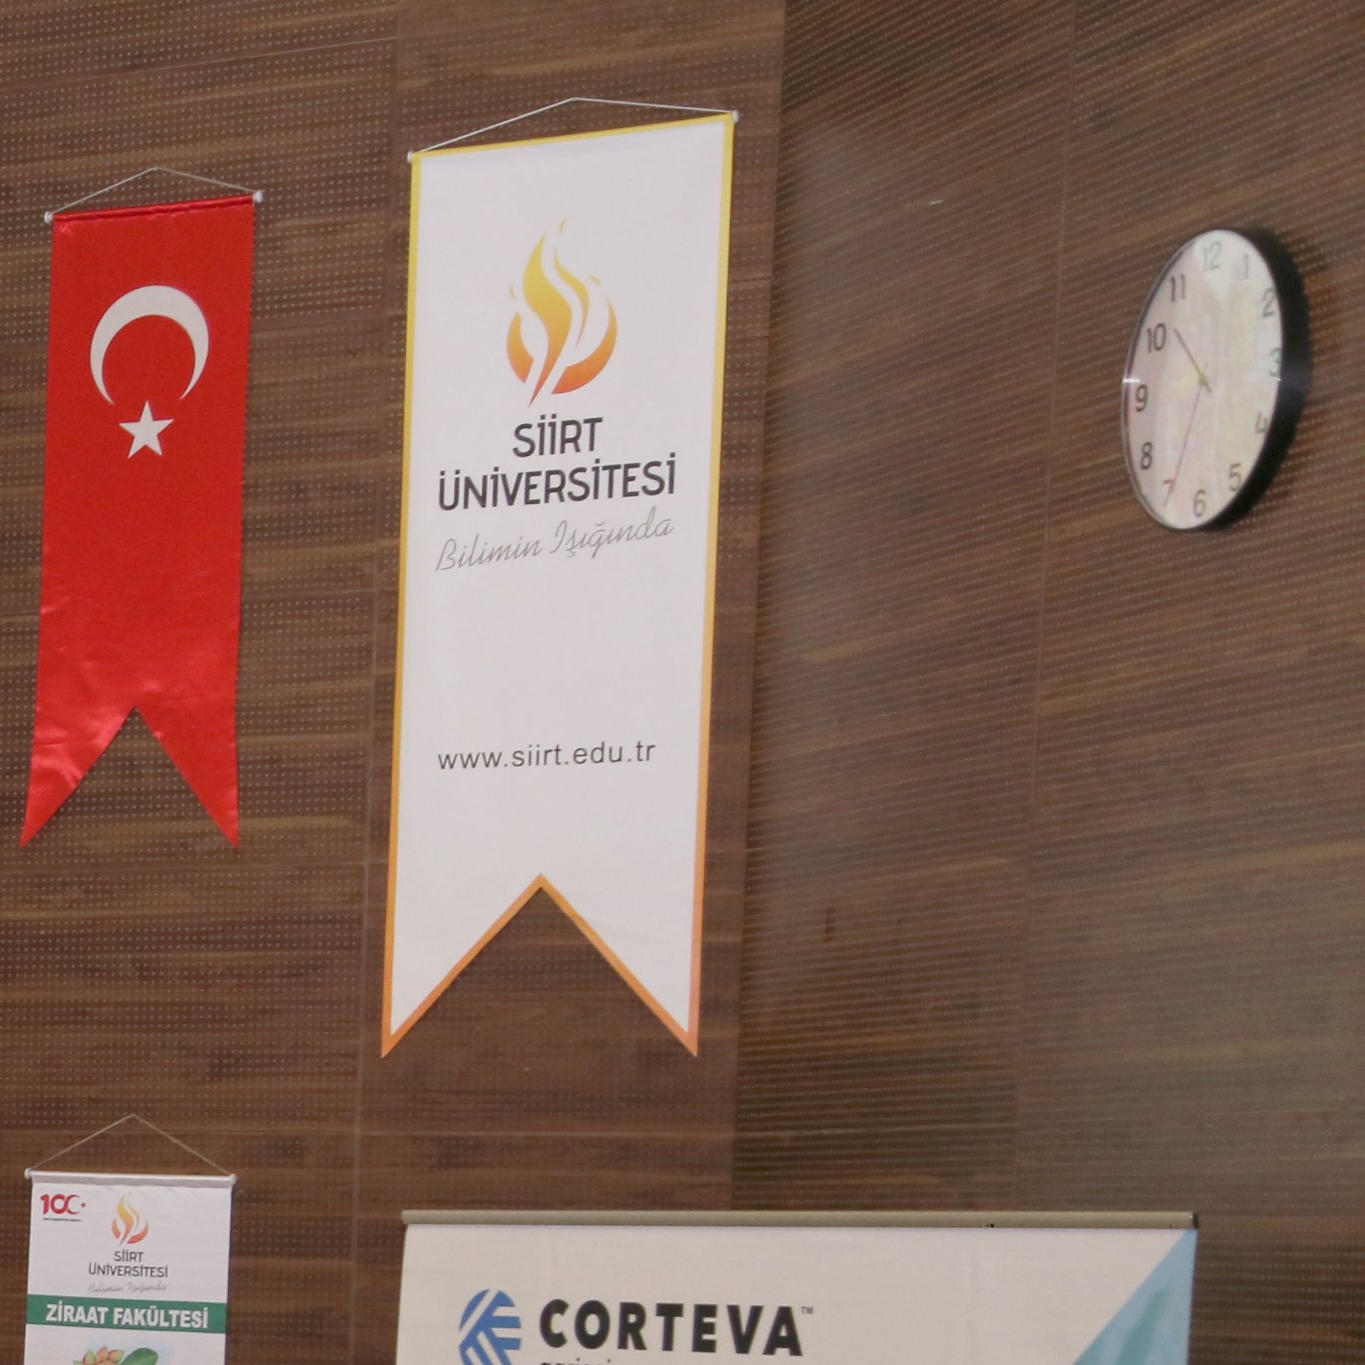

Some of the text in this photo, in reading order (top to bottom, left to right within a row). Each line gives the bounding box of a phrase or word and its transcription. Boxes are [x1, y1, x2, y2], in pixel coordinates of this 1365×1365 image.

[1202, 240, 1224, 271] 12
[1170, 273, 1187, 303] 11
[1262, 287, 1275, 318] 2
[1146, 322, 1166, 354] 10
[1135, 384, 1149, 412] 9
[513, 415, 603, 458] SİİRT
[1255, 411, 1269, 434] 4
[1140, 441, 1153, 470] 8
[438, 453, 677, 511] ÜNİVERSİTESİ
[1229, 463, 1243, 492] 5
[1193, 488, 1207, 518] 6
[435, 507, 673, 571] Bilimin Işığında
[437, 741, 656, 771] www.siirt.edu.tr
[46, 1300, 208, 1329] ZİRAAT FAKÜLTESİ
